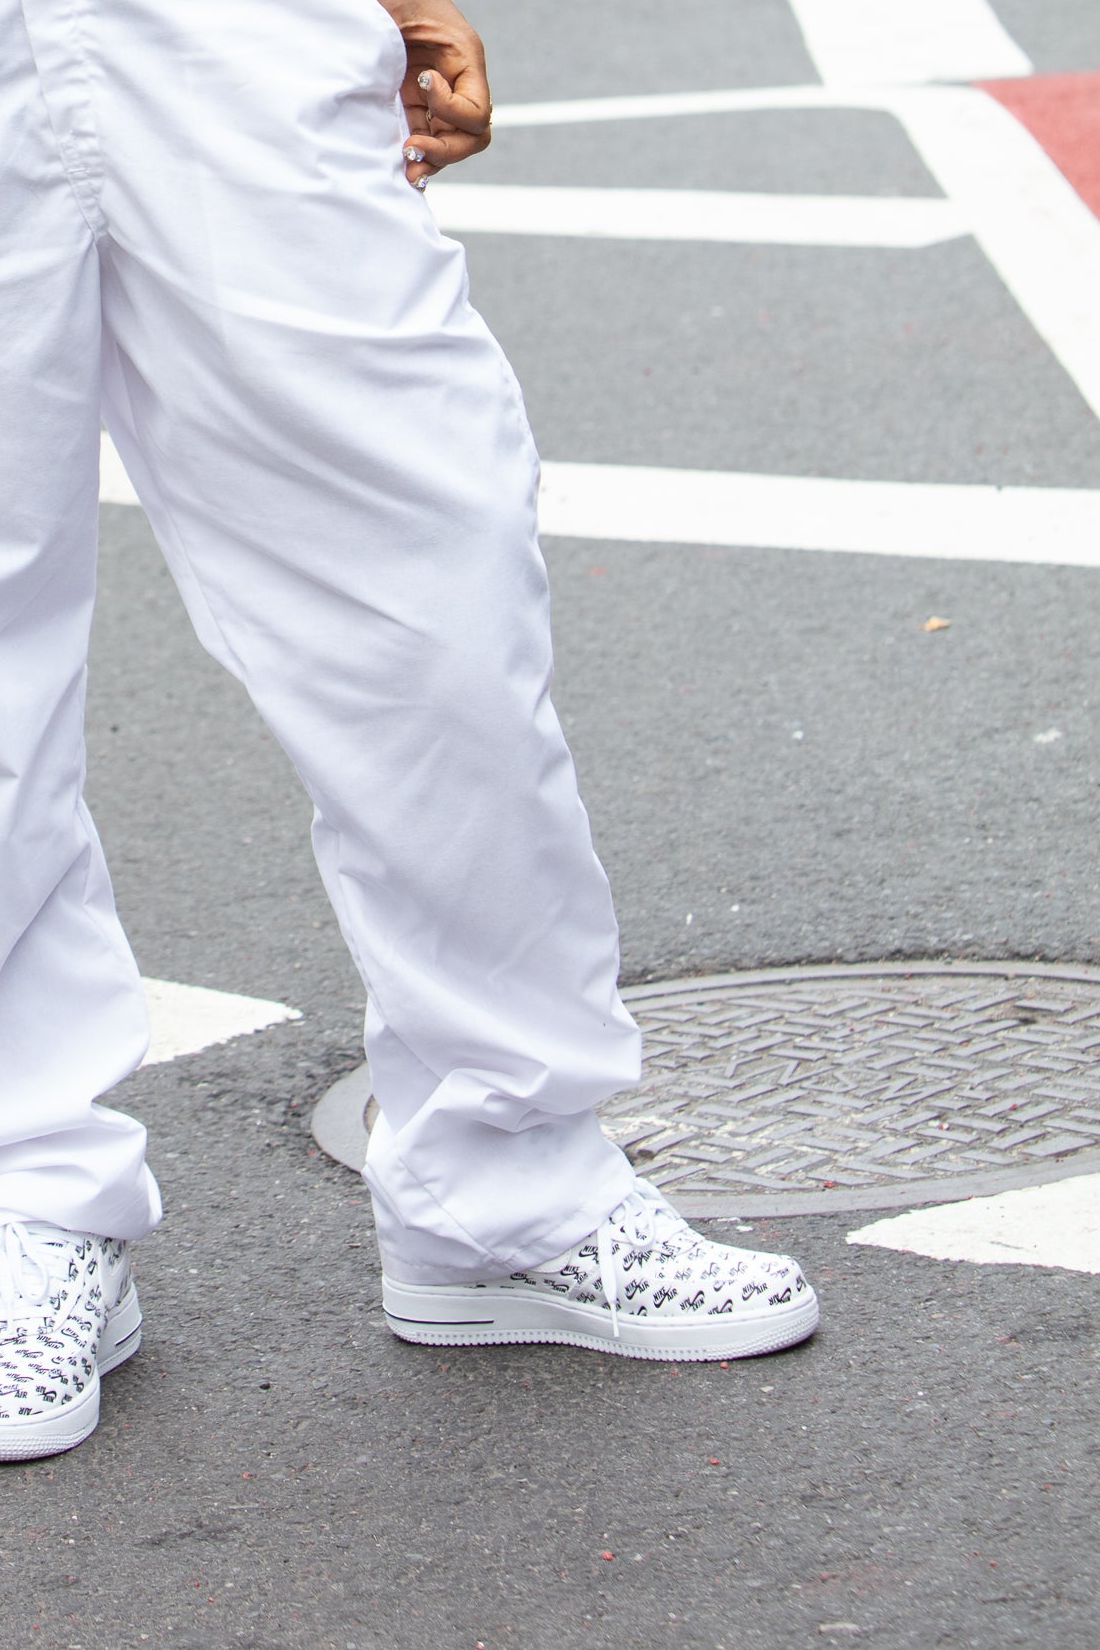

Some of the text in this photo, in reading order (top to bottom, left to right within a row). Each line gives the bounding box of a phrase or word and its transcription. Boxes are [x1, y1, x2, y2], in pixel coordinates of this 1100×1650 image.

[639, 1279, 651, 1294] AIR
[667, 1287, 679, 1302] AIR
[14, 1390, 28, 1399] AIR
